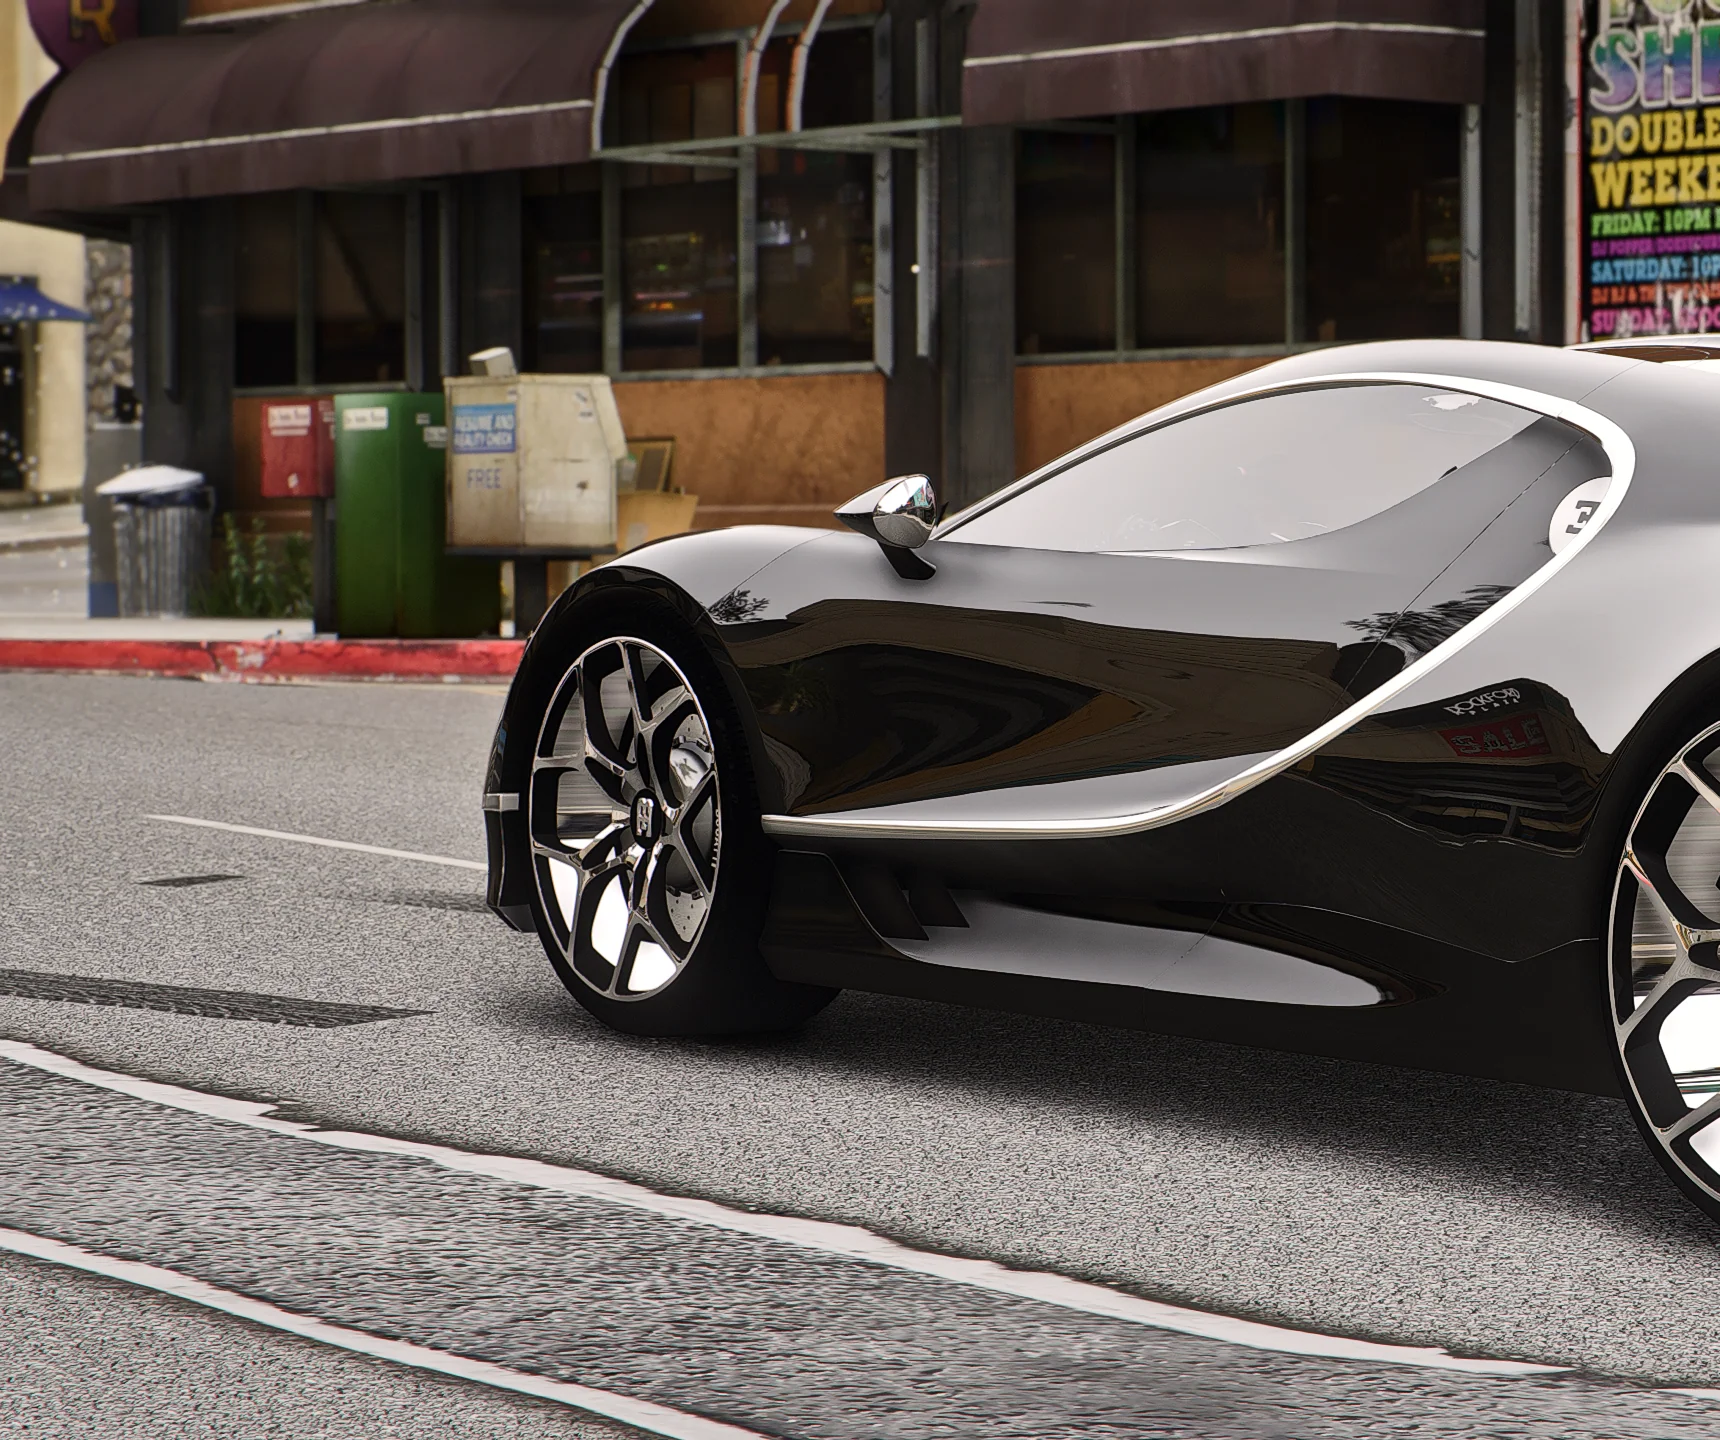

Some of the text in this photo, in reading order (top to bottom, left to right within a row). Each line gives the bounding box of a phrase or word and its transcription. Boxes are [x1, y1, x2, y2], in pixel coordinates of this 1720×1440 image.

[1591, 209, 1660, 237] FRIDAY:
[1664, 206, 1711, 232] 10PM
[1591, 256, 1688, 284] SATURDAY:
[467, 468, 503, 490] FREE
